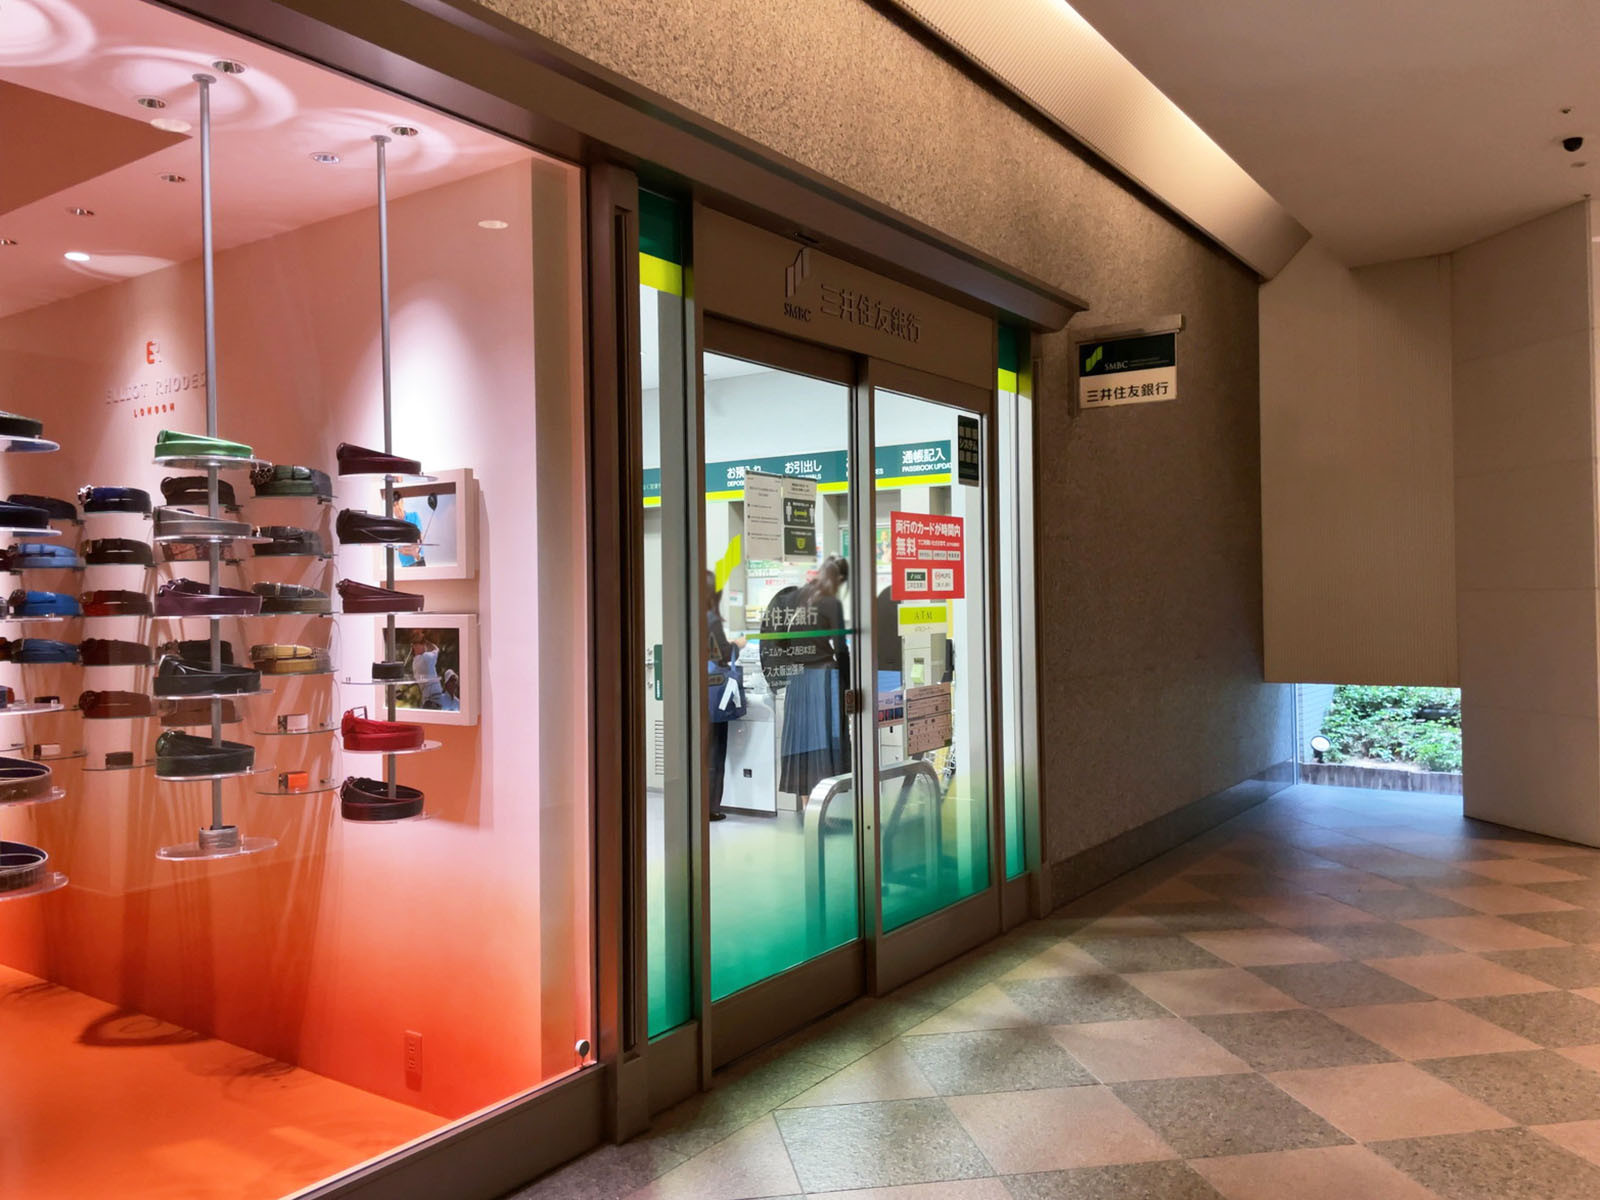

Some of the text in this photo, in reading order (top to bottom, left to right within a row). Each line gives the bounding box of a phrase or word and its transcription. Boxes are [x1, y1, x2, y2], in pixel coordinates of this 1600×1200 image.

[784, 303, 812, 322] SMBC
[820, 283, 921, 343] 三井住友銀行
[1104, 360, 1129, 371] SMBC
[1086, 381, 1169, 403] 三井住友銀行
[133, 402, 175, 418] LONDON
[902, 447, 946, 464] 通帳記入
[784, 460, 822, 474] お引出し
[901, 464, 934, 472] PASSBOOK
